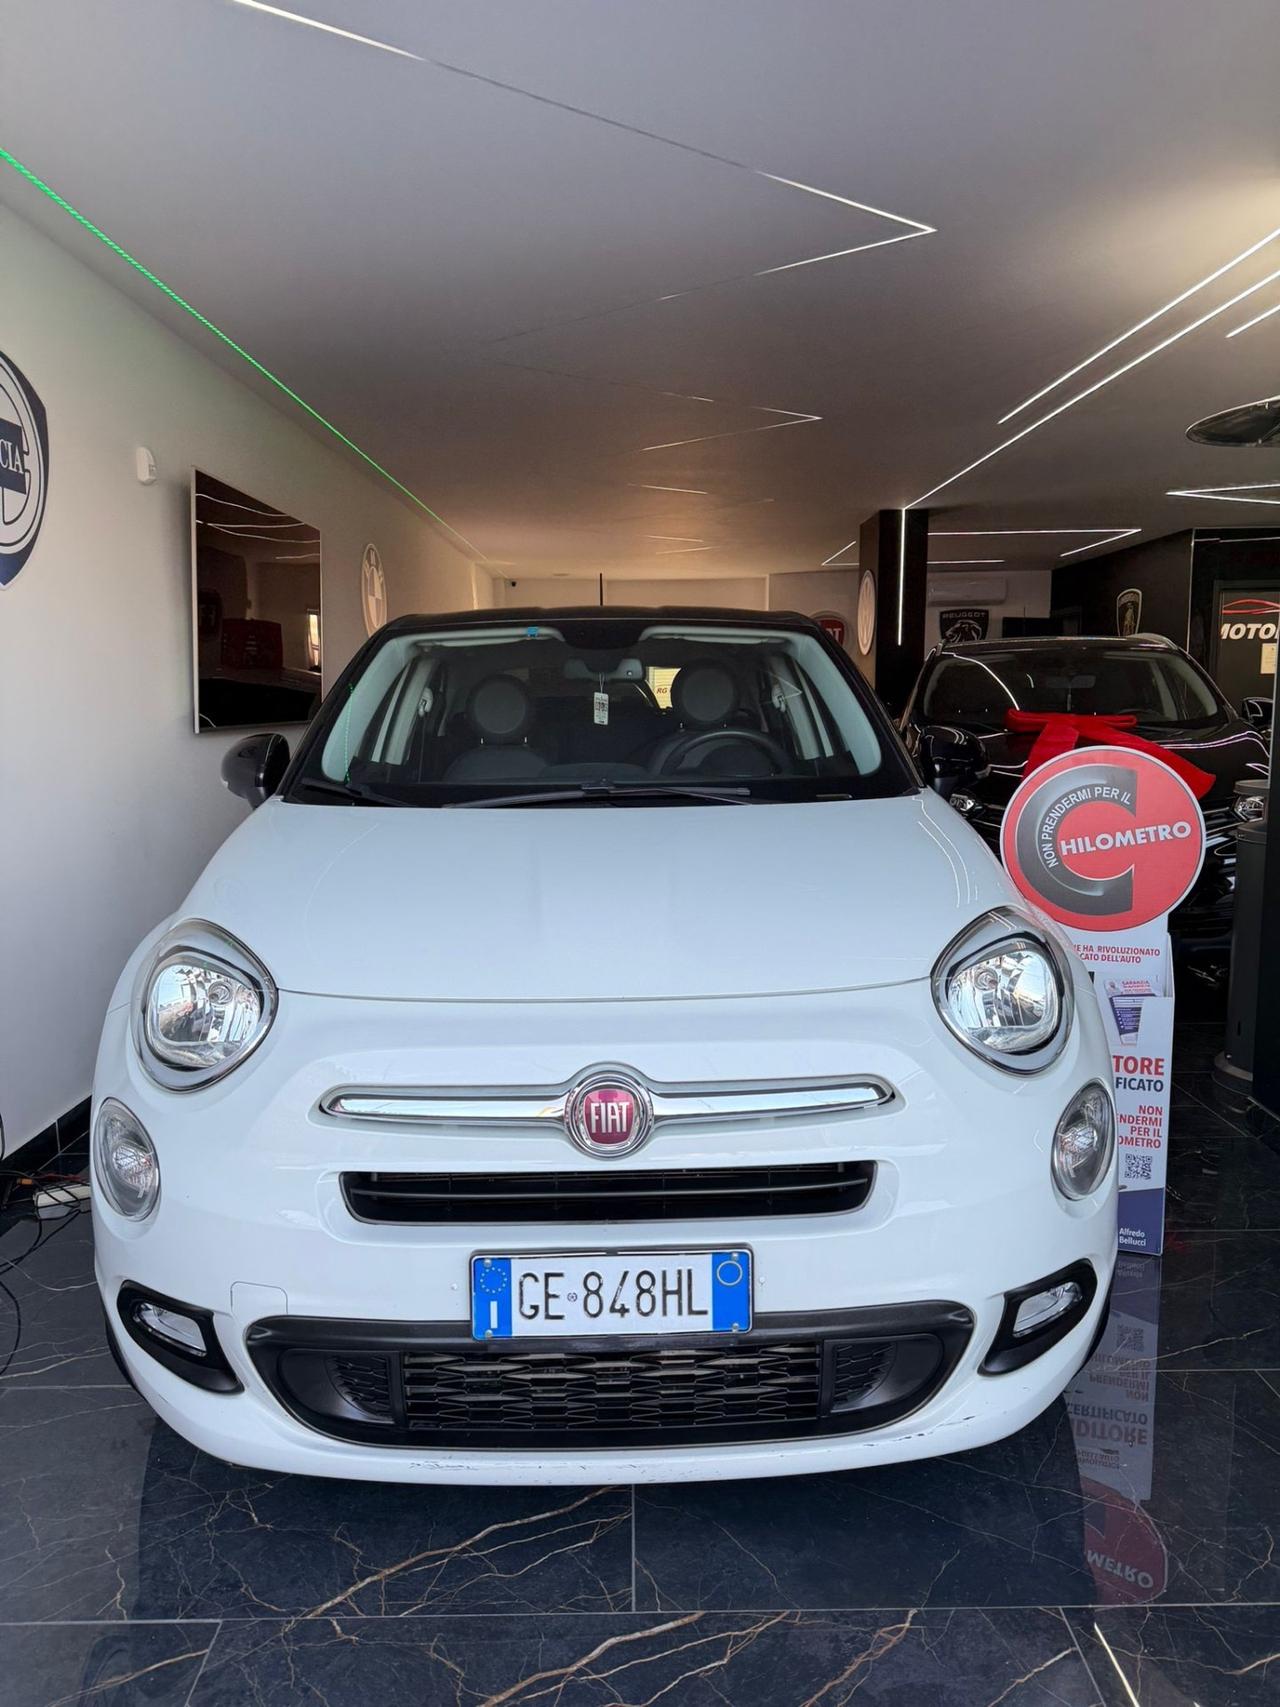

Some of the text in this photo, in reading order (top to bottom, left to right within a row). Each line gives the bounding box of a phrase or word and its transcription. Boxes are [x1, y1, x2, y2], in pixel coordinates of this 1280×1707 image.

[1041, 786, 1132, 868] NON PRENDERMI PER IL
[1060, 821, 1192, 856] HILOMETRO
[1097, 946, 1161, 956] RIVOLUZIONATO
[1101, 955, 1142, 964] DELL'AUTO
[1113, 1055, 1165, 1076] TORE
[1115, 1077, 1164, 1093] FICATO
[590, 1102, 630, 1134] FIAT
[1139, 1105, 1163, 1116] NON
[1117, 1113, 1162, 1128] NDERMI
[1130, 1126, 1162, 1138] PER IL
[1119, 1227, 1146, 1238] Alfredo
[1119, 1236, 1147, 1247] Bellucci
[518, 1271, 565, 1321] GE
[582, 1268, 709, 1319] 848HL
